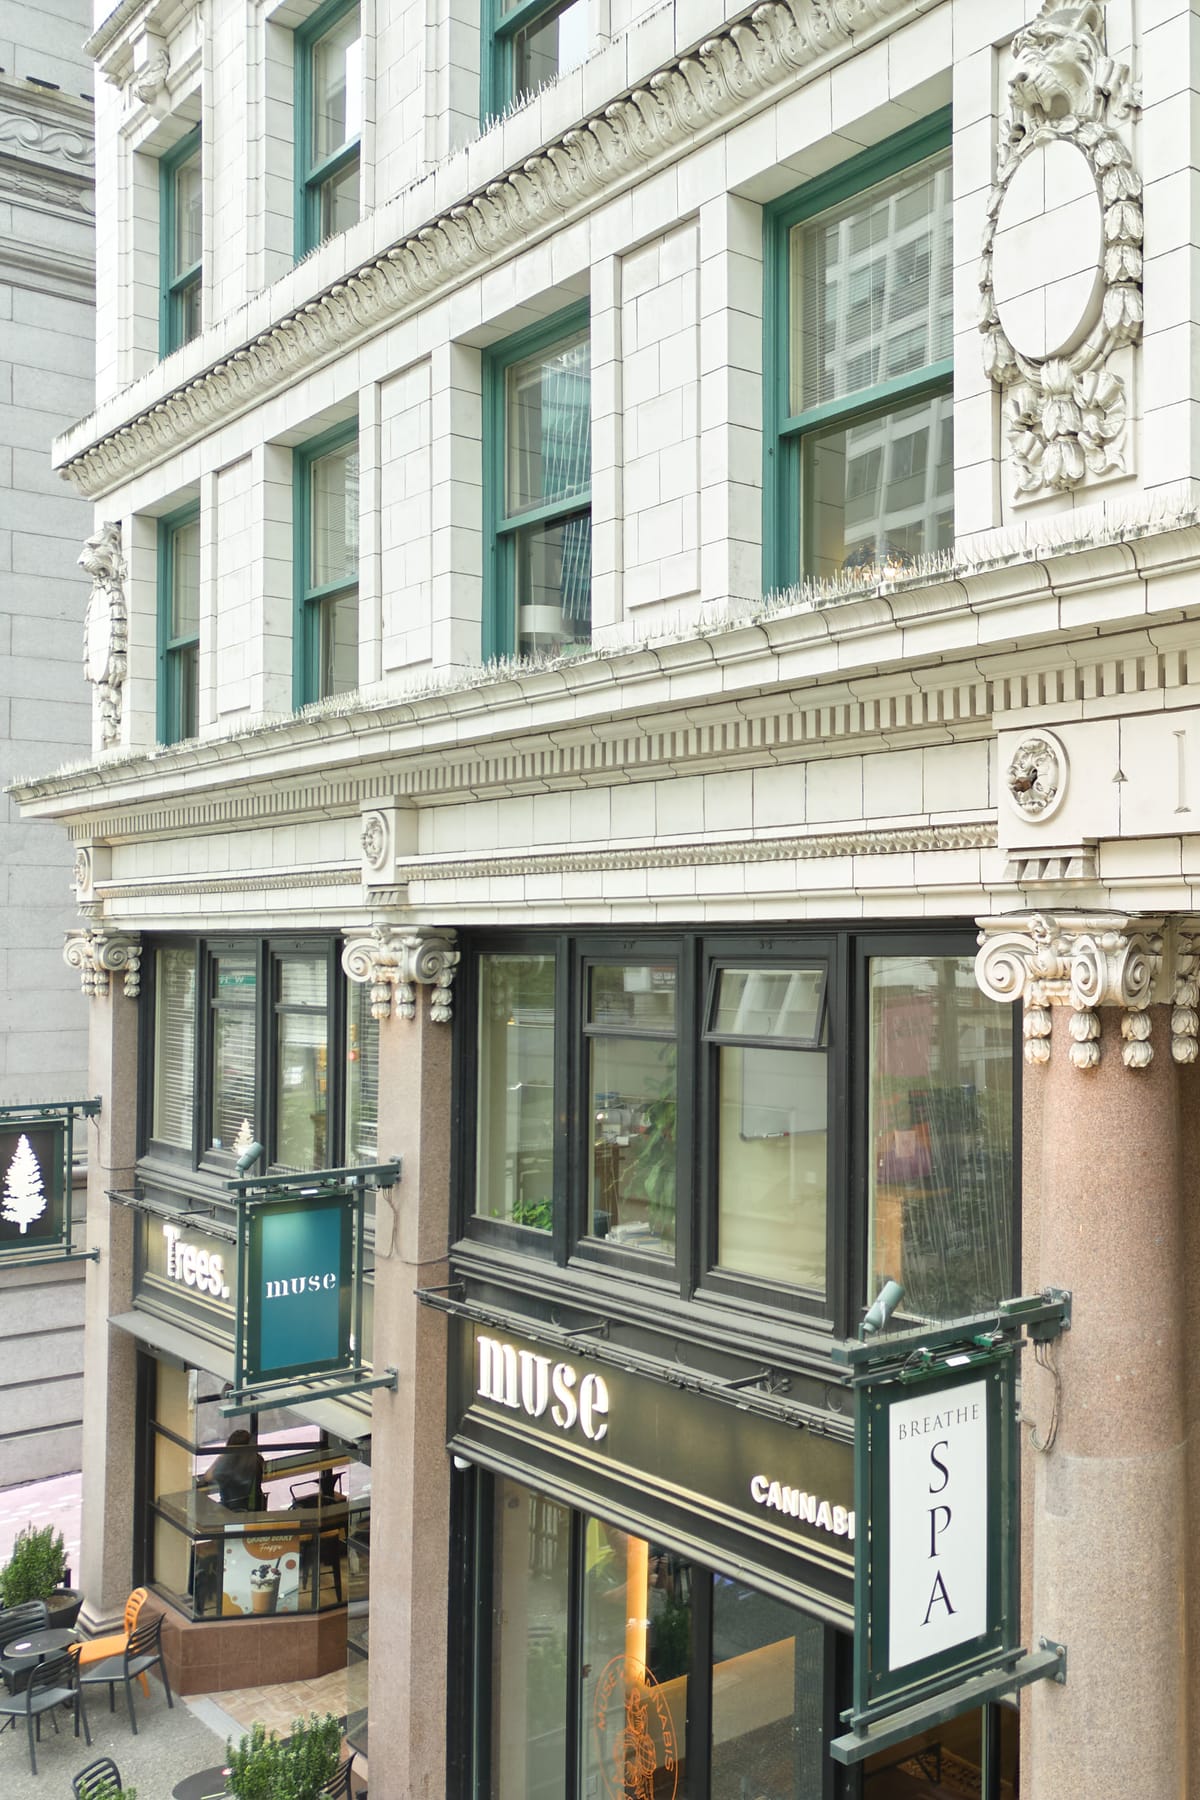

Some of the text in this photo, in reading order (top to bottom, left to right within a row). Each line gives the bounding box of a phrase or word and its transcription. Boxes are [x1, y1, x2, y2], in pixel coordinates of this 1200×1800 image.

[265, 1272, 337, 1299] muse
[476, 1335, 610, 1441] muse
[898, 1403, 980, 1441] BREATHE
[750, 1474, 856, 1540] CANNABI
